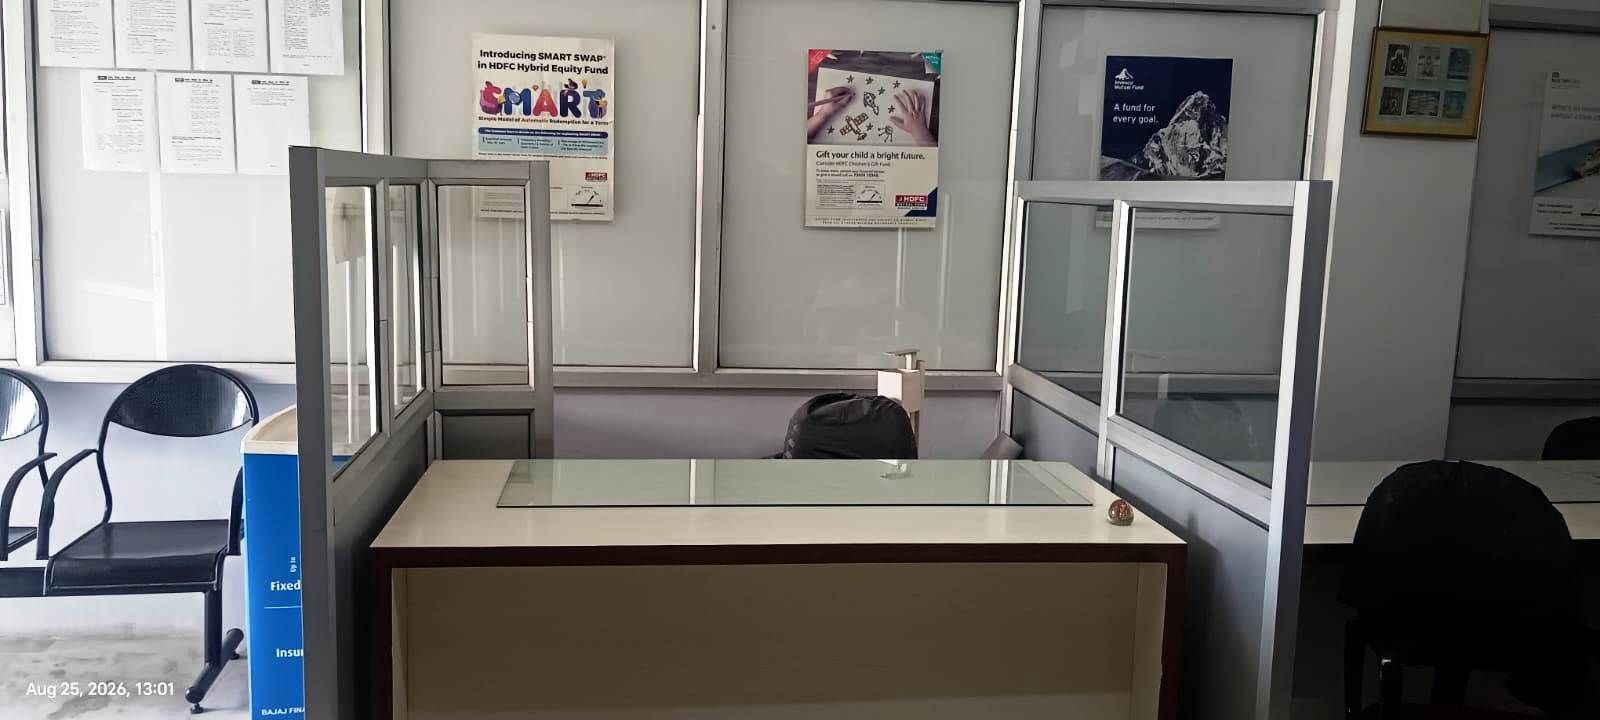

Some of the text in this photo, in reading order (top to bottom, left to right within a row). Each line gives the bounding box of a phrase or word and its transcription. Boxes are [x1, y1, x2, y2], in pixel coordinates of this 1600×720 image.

[480, 50, 536, 61] Introducing
[538, 52, 572, 61] SMART
[478, 61, 608, 75] in HDFC Hybrid Equity Fund
[480, 82, 608, 118] SMART
[1114, 103, 1156, 112] A fund for
[1113, 115, 1159, 125] every goal.
[816, 150, 830, 158] Gift
[831, 152, 849, 160] your
[850, 151, 868, 159] child
[876, 152, 900, 161] bright
[900, 152, 925, 160] future.
[270, 580, 301, 591] Fixed
[261, 708, 288, 716] BAJAJ
